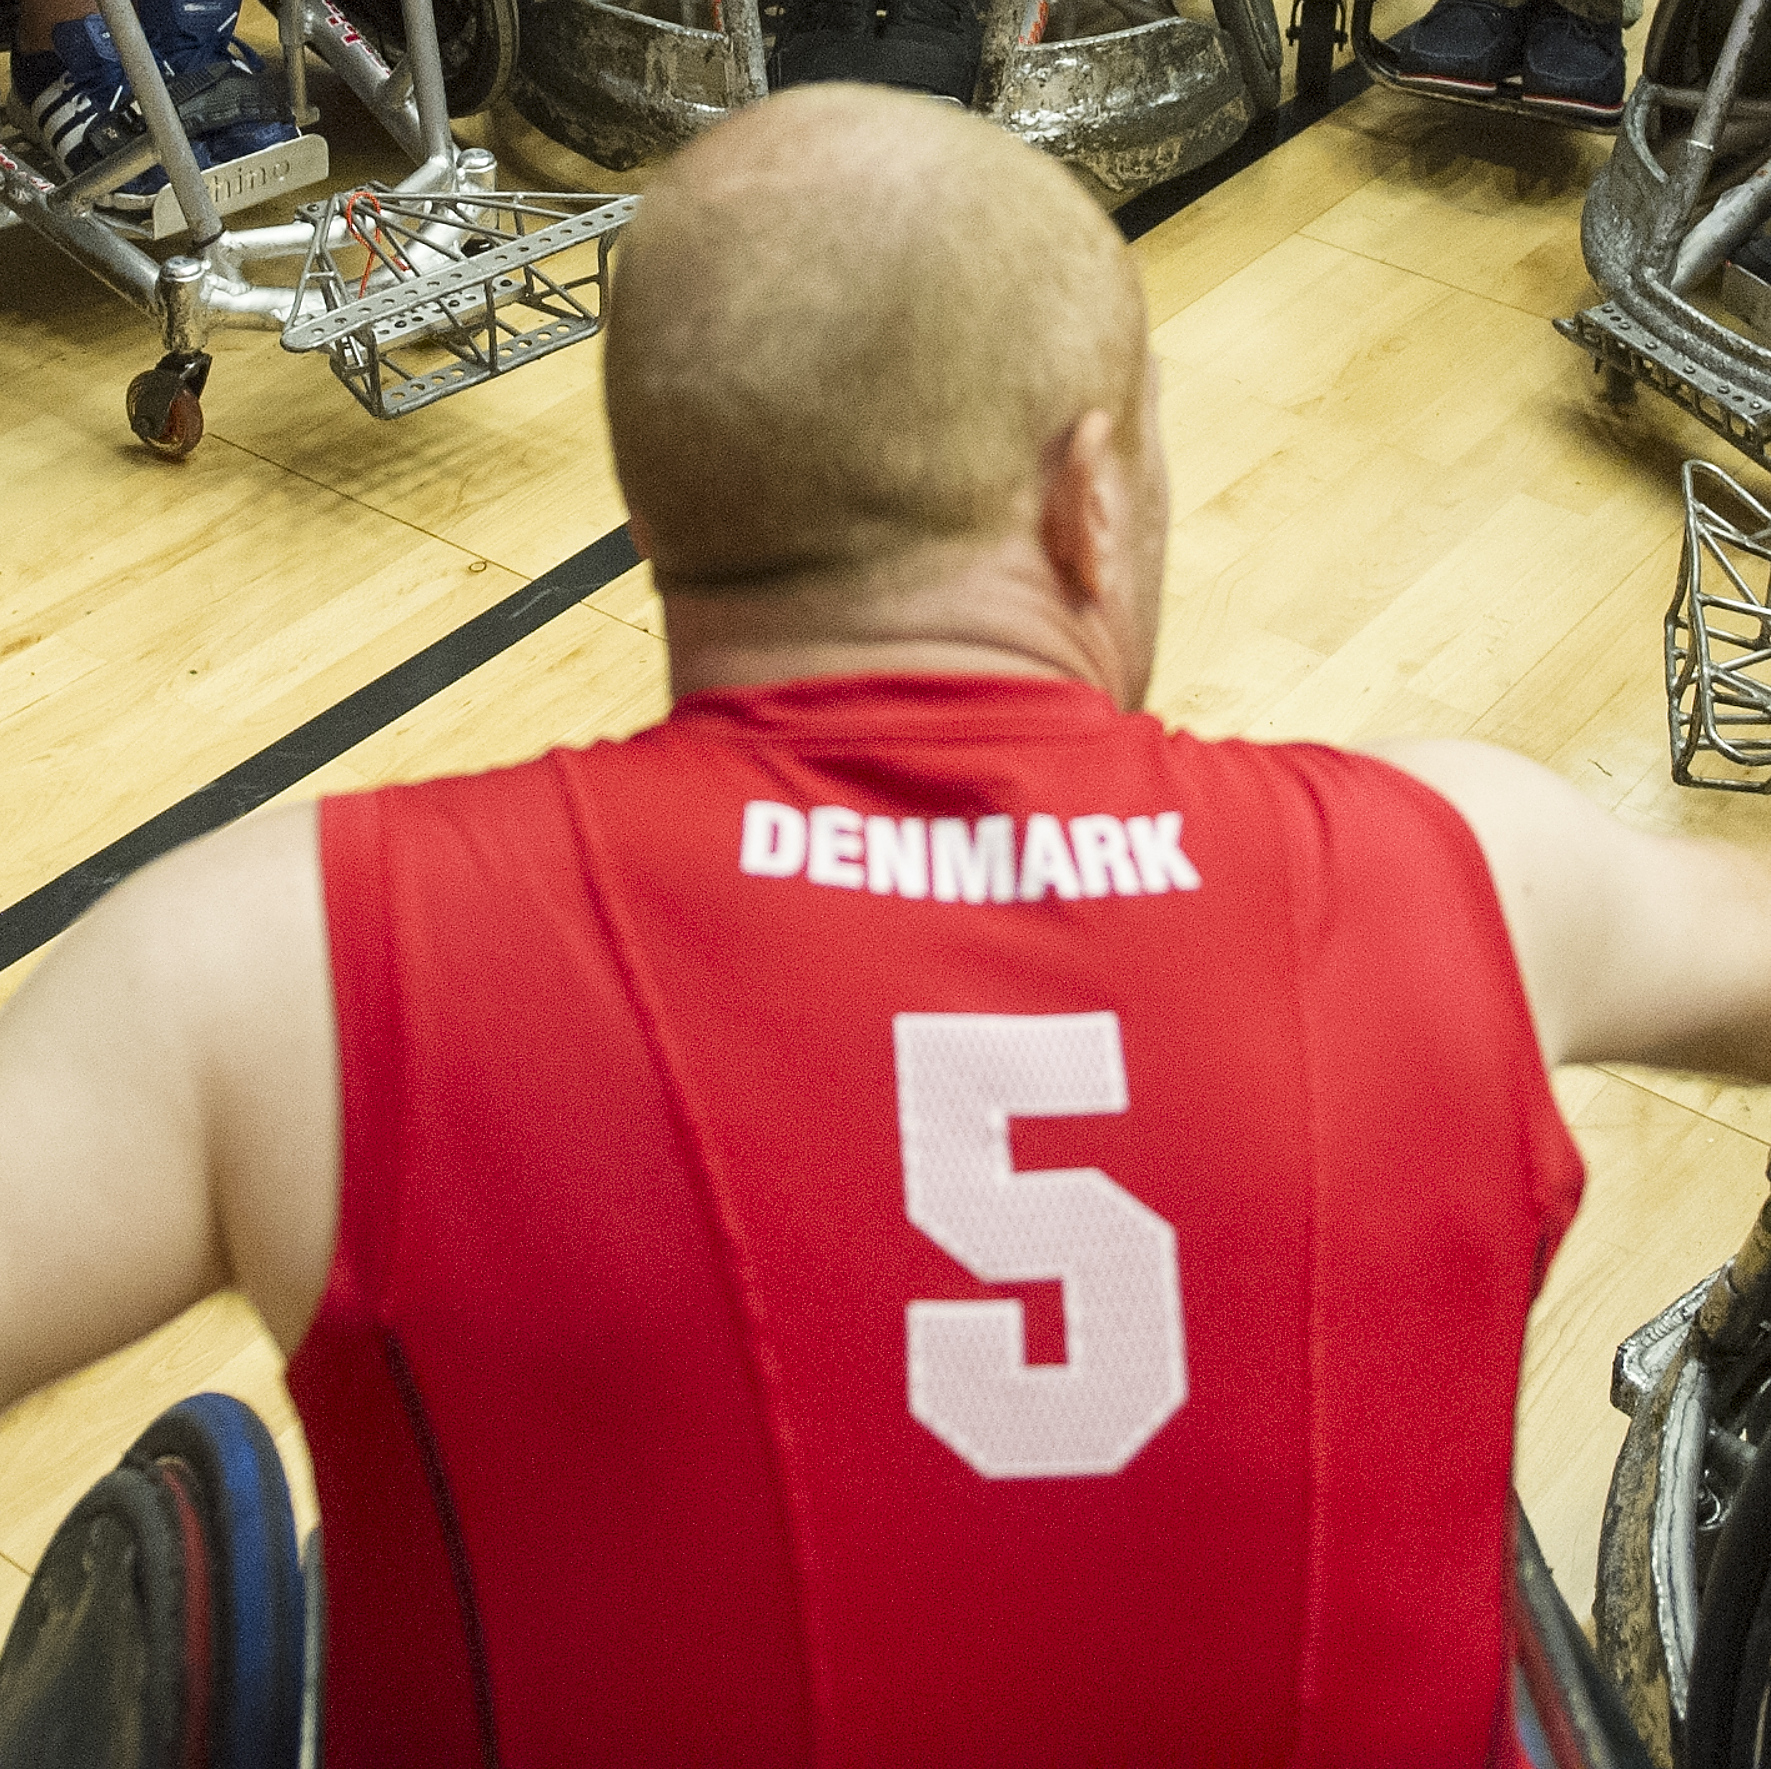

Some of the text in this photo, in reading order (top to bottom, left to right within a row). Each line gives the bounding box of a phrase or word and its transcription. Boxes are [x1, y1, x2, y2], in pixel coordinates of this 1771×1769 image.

[208, 158, 293, 203] hino
[738, 798, 1203, 906] DENMARK
[892, 1009, 1190, 1480] 5
